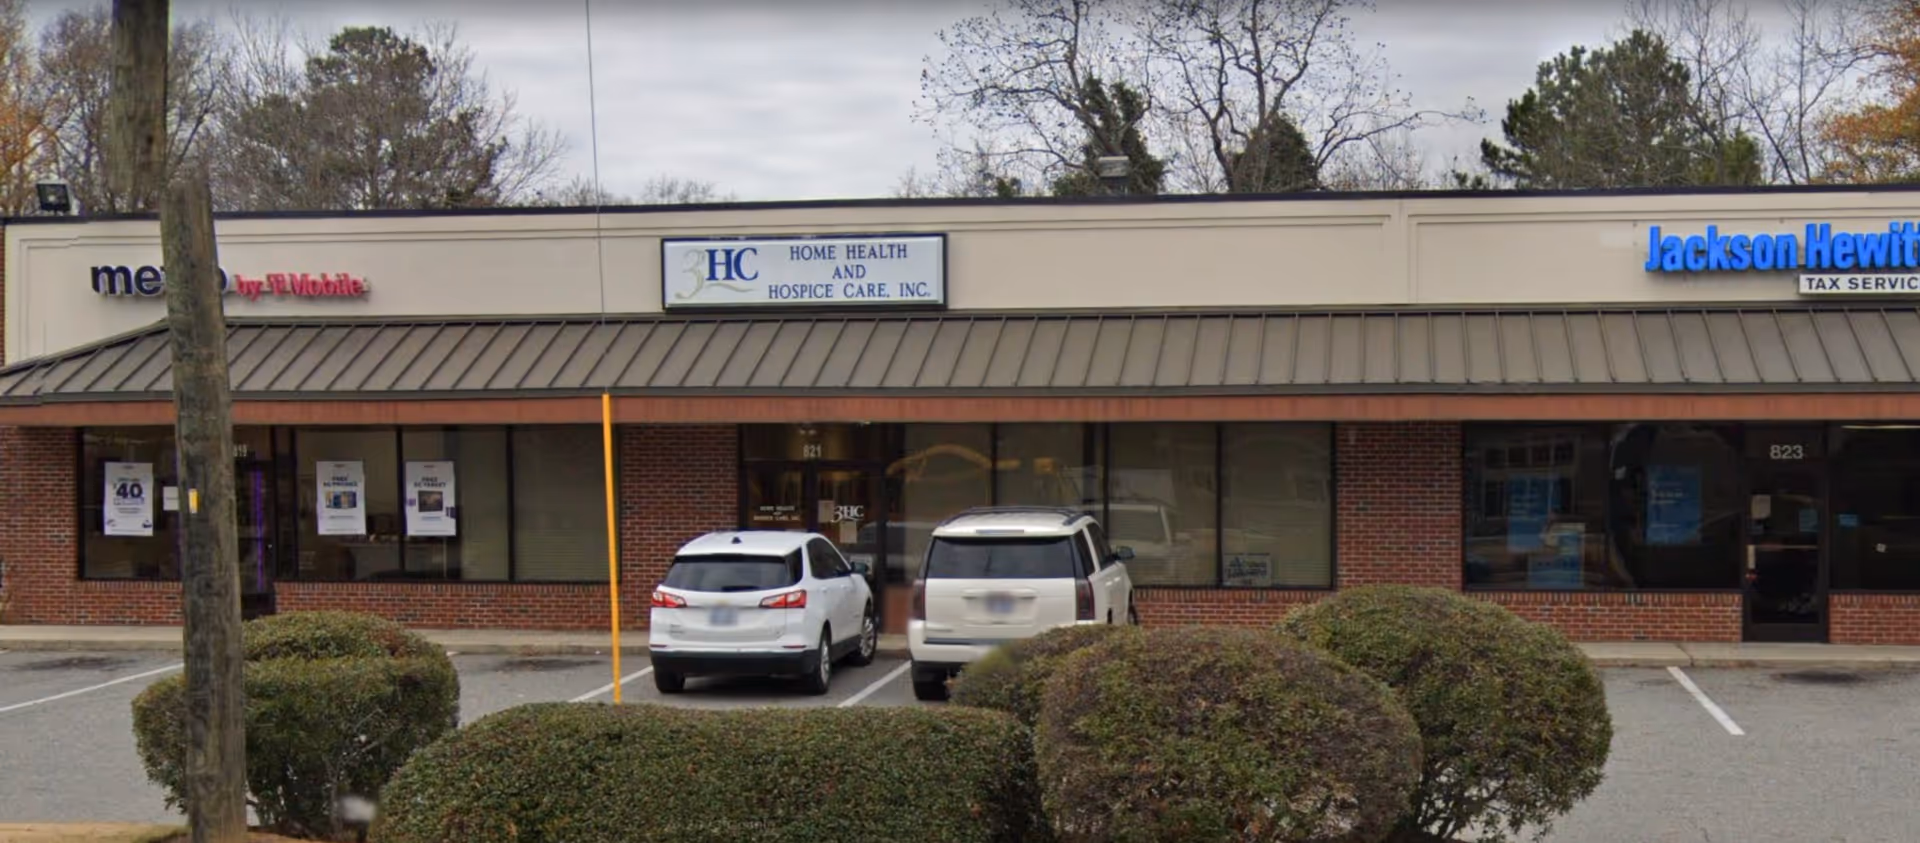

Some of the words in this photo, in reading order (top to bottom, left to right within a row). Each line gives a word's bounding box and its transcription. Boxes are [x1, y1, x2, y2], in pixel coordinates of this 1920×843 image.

[790, 245, 837, 261] HOME
[846, 244, 907, 259] HEALTH
[1645, 225, 1799, 272] Jackson
[1805, 222, 1920, 269] Hewit
[832, 264, 867, 280] AND
[235, 274, 262, 301] by
[768, 284, 833, 300] HOSPICE
[1806, 278, 1841, 290] TAX
[803, 445, 822, 458] 821
[1770, 445, 1804, 460] 823
[831, 505, 864, 523] 3HC
